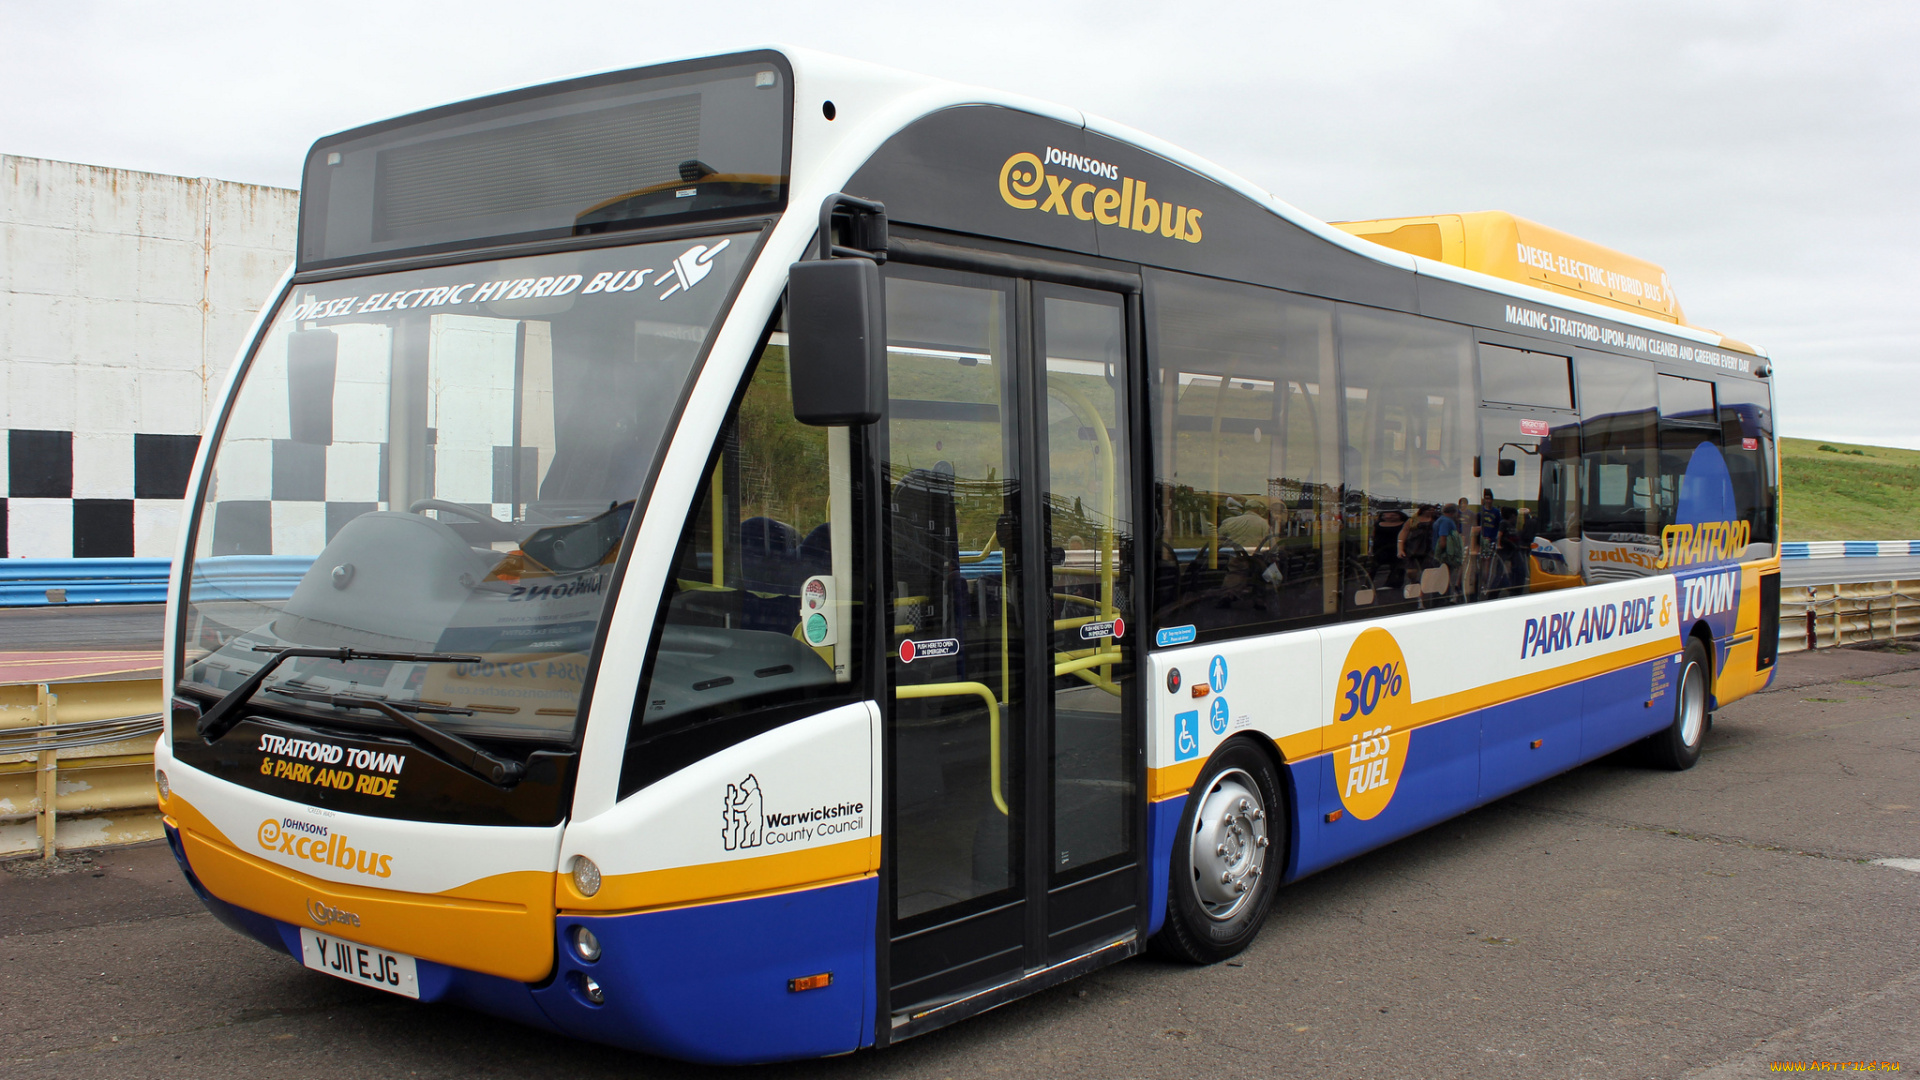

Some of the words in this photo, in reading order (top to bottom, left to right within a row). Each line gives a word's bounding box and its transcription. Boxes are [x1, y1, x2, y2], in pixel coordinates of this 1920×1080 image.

[1044, 146, 1119, 180] JOHNSONS
[1517, 243, 1606, 287] DIESEL-ELECTRIC
[1607, 271, 1643, 297] HYBRID
[1644, 282, 1661, 302] BUS
[285, 283, 476, 322] DIESEL-ELECTRIC
[467, 274, 584, 303] HYBRID
[581, 268, 654, 295] BUS
[1506, 305, 1548, 331] MAKING
[1549, 315, 1648, 351] STRATFORD-UPON-AVON
[1648, 338, 1678, 358] CLEANER
[1679, 346, 1694, 361] AND
[1694, 350, 1721, 367] GREENER
[1721, 356, 1739, 371] EVERY
[1739, 360, 1750, 373] DAY
[1657, 520, 1751, 569] STRATFORD
[1683, 571, 1737, 622] TOWN
[1520, 610, 1576, 660] PARK
[1575, 603, 1617, 647] AND
[1619, 596, 1656, 636] RIDE
[1659, 594, 1672, 627] &
[1339, 661, 1402, 721] 30%
[258, 734, 343, 764] STRATFORD
[346, 748, 405, 775] TOWN
[1349, 725, 1392, 765] LESS
[260, 757, 274, 775] &
[274, 760, 314, 784] PARK
[313, 768, 354, 791] AND
[355, 774, 399, 799] RIDE
[1345, 757, 1389, 798] FUEL
[282, 817, 328, 837] JOHNSONS
[765, 826, 814, 845] County
[817, 816, 864, 836] Council
[766, 802, 864, 828] Warwickshire
[309, 899, 361, 927] Optare
[316, 936, 353, 974] YJ11
[356, 948, 399, 986] EJG
